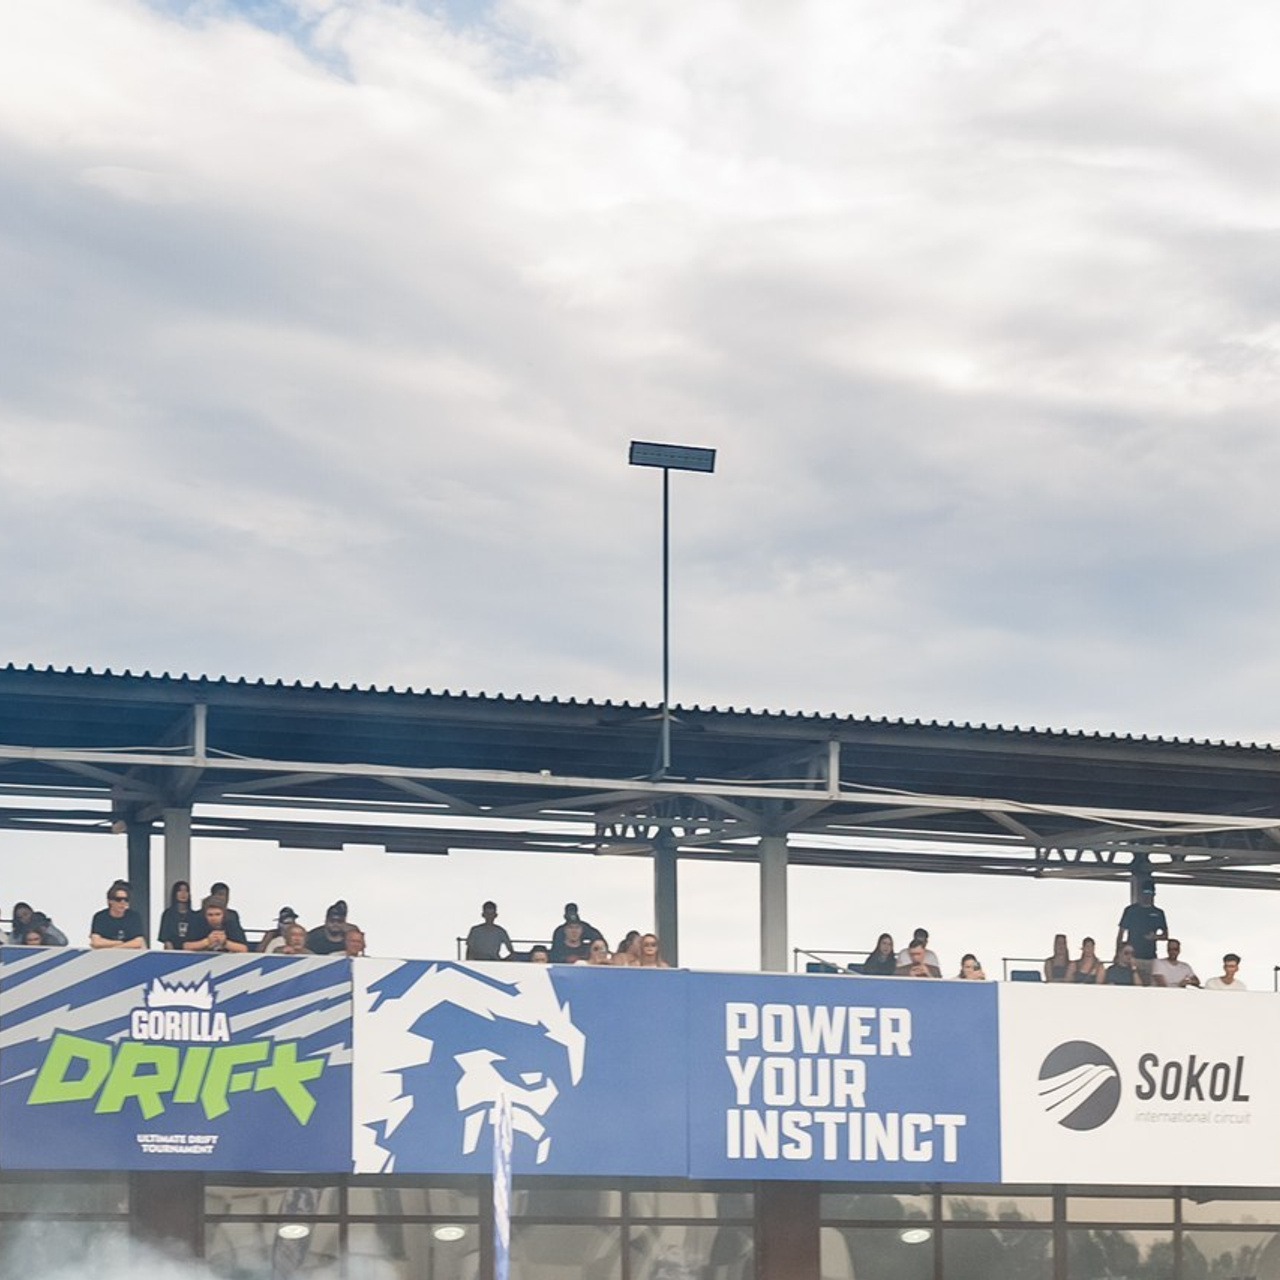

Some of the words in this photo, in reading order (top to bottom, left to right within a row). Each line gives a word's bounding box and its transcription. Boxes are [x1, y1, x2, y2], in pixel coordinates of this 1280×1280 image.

[131, 1009, 231, 1042] GORILLA
[725, 1003, 912, 1057] POWER
[26, 1033, 325, 1126] DRIFT
[725, 1056, 867, 1108] YOUR
[726, 1109, 967, 1163] INSTINCT
